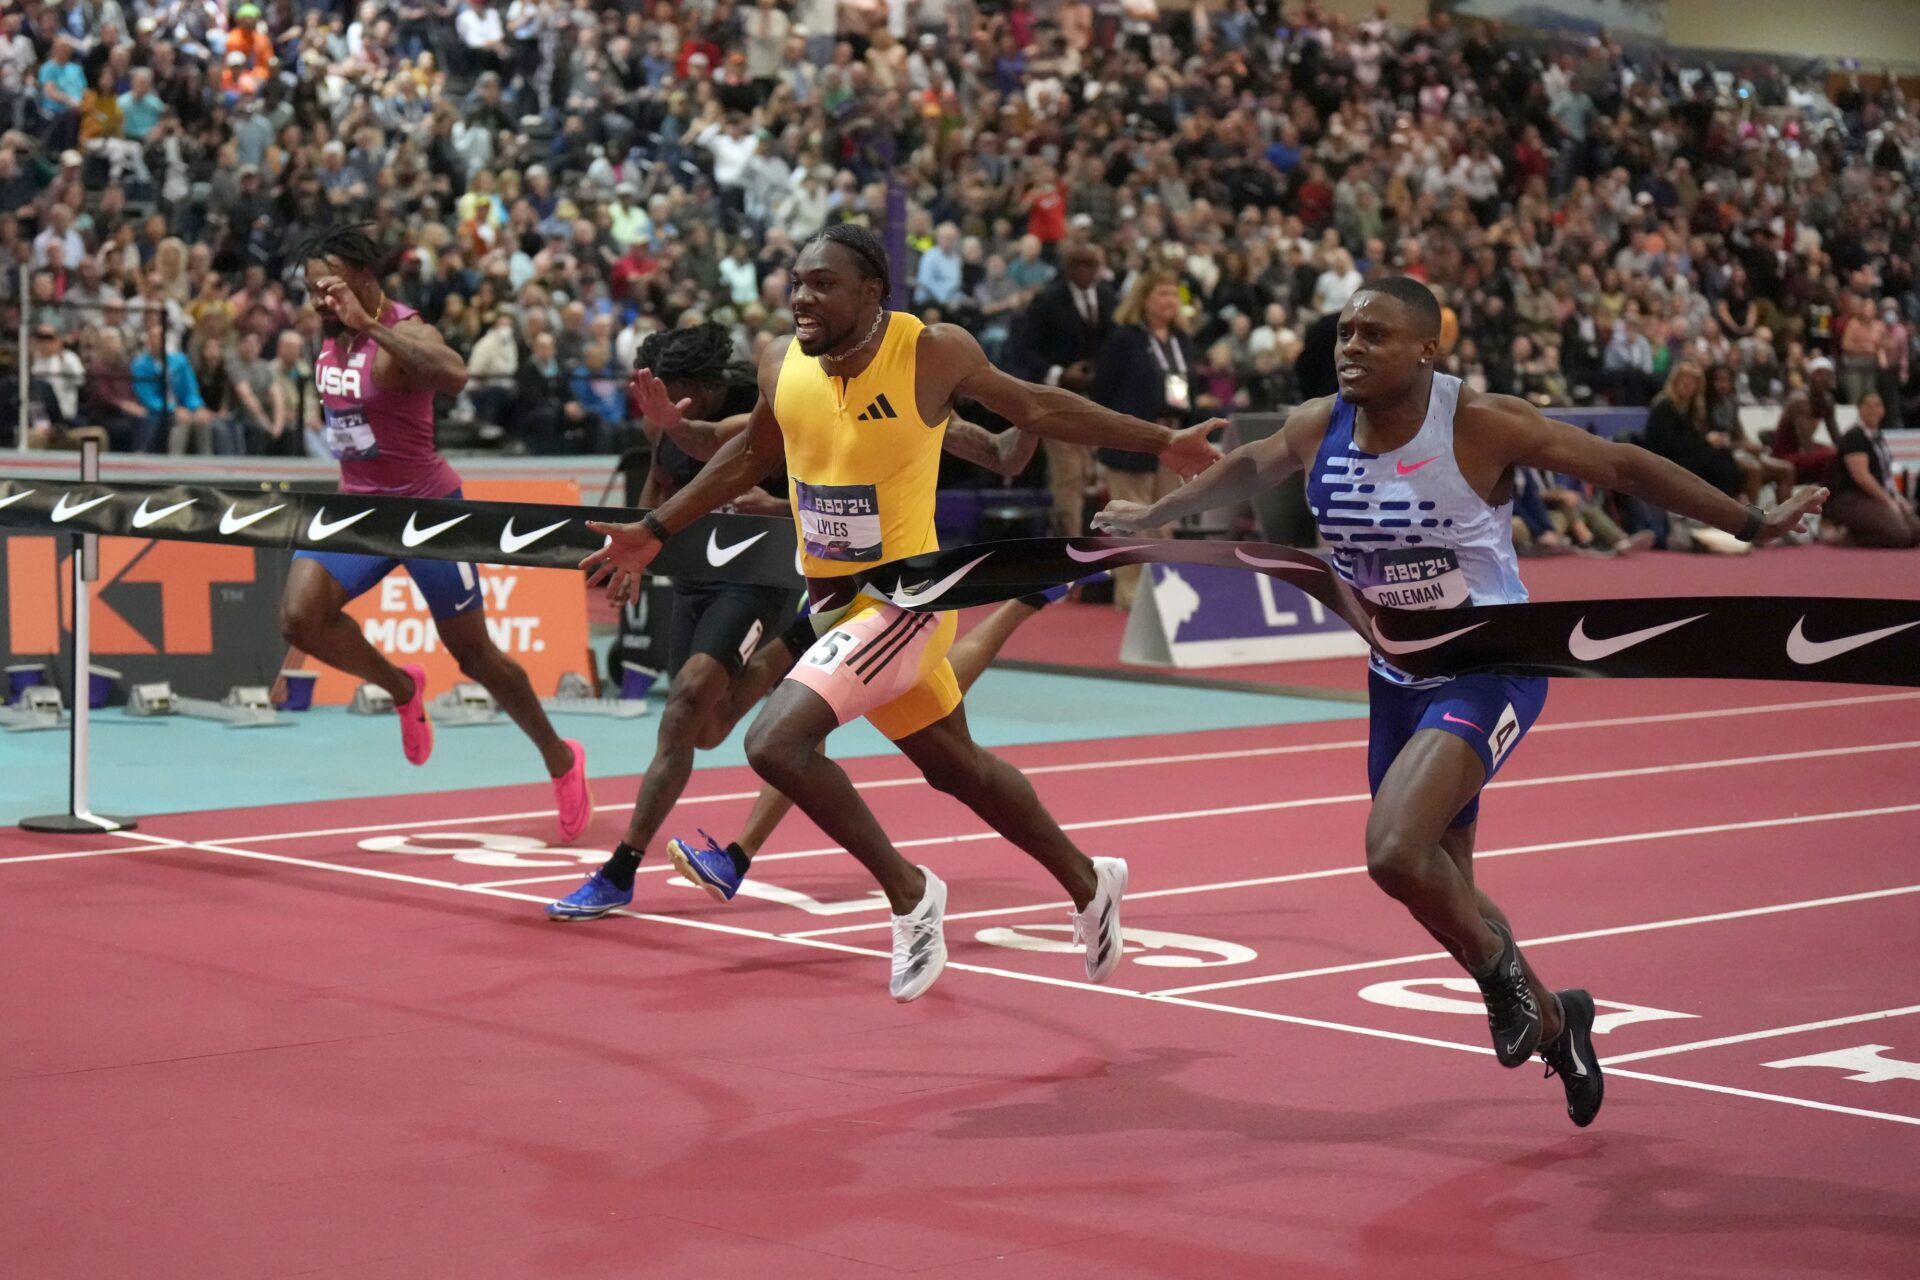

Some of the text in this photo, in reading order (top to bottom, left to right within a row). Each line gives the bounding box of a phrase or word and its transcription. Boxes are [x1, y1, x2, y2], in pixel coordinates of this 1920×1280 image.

[315, 360, 362, 399] USA
[815, 497, 872, 516] ABQ'24
[817, 518, 849, 538] LYLES
[1384, 557, 1452, 583] ABQ'24
[380, 575, 518, 612] EVY
[1378, 582, 1445, 607] COLEMAN
[364, 616, 546, 654] MOMNT.
[810, 630, 852, 666] 5
